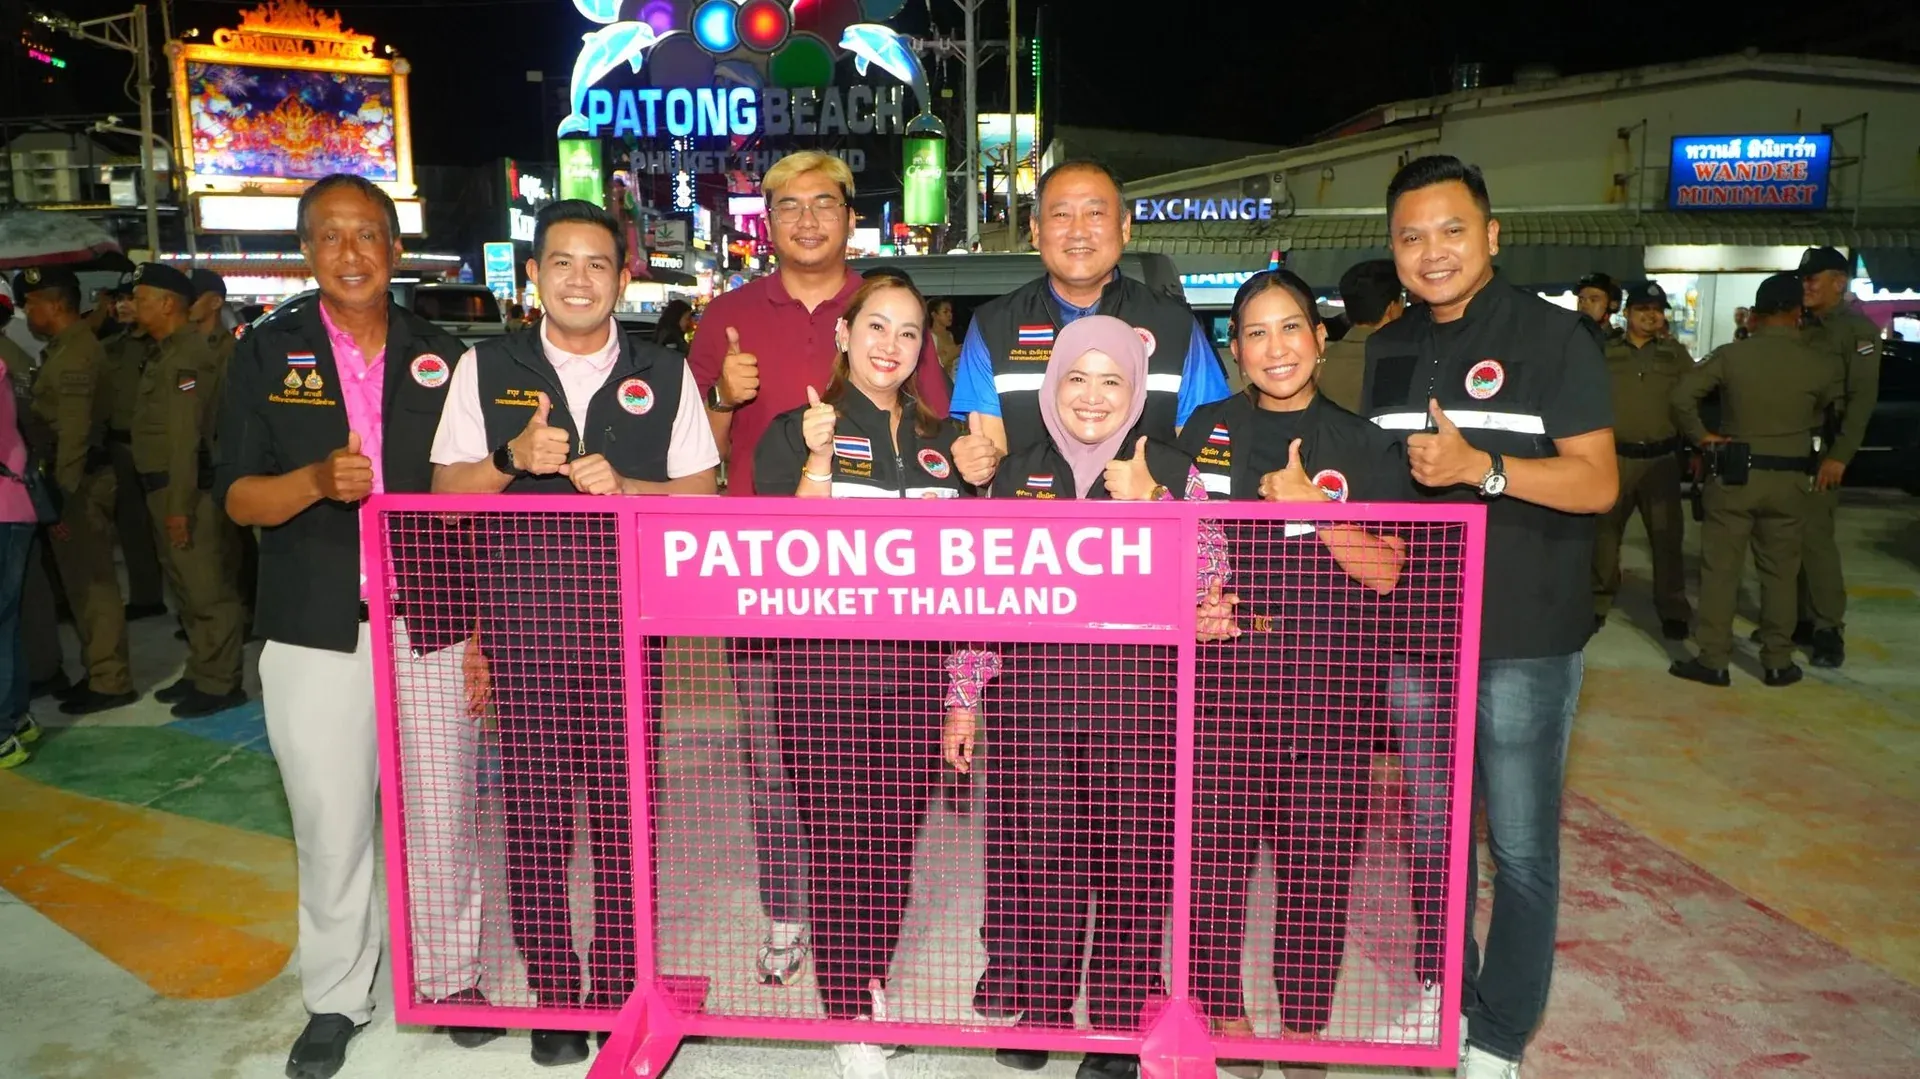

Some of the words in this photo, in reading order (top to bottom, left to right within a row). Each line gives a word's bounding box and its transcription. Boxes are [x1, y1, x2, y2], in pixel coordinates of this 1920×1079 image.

[213, 28, 303, 52] CARNIVAL
[313, 35, 375, 60] MAGIC
[588, 86, 757, 138] PATONG
[762, 85, 905, 137] BEACH
[630, 149, 728, 174] PHUKET
[1693, 161, 1808, 182] WANDEE
[1677, 184, 1818, 206] MINIMART
[1135, 198, 1273, 220] EXCHANGE
[650, 256, 683, 269] TATTOO
[663, 528, 916, 578] PATONG
[940, 526, 1153, 576] BEACH
[737, 587, 879, 616] PHUKET
[888, 586, 1077, 615] THAILAND
